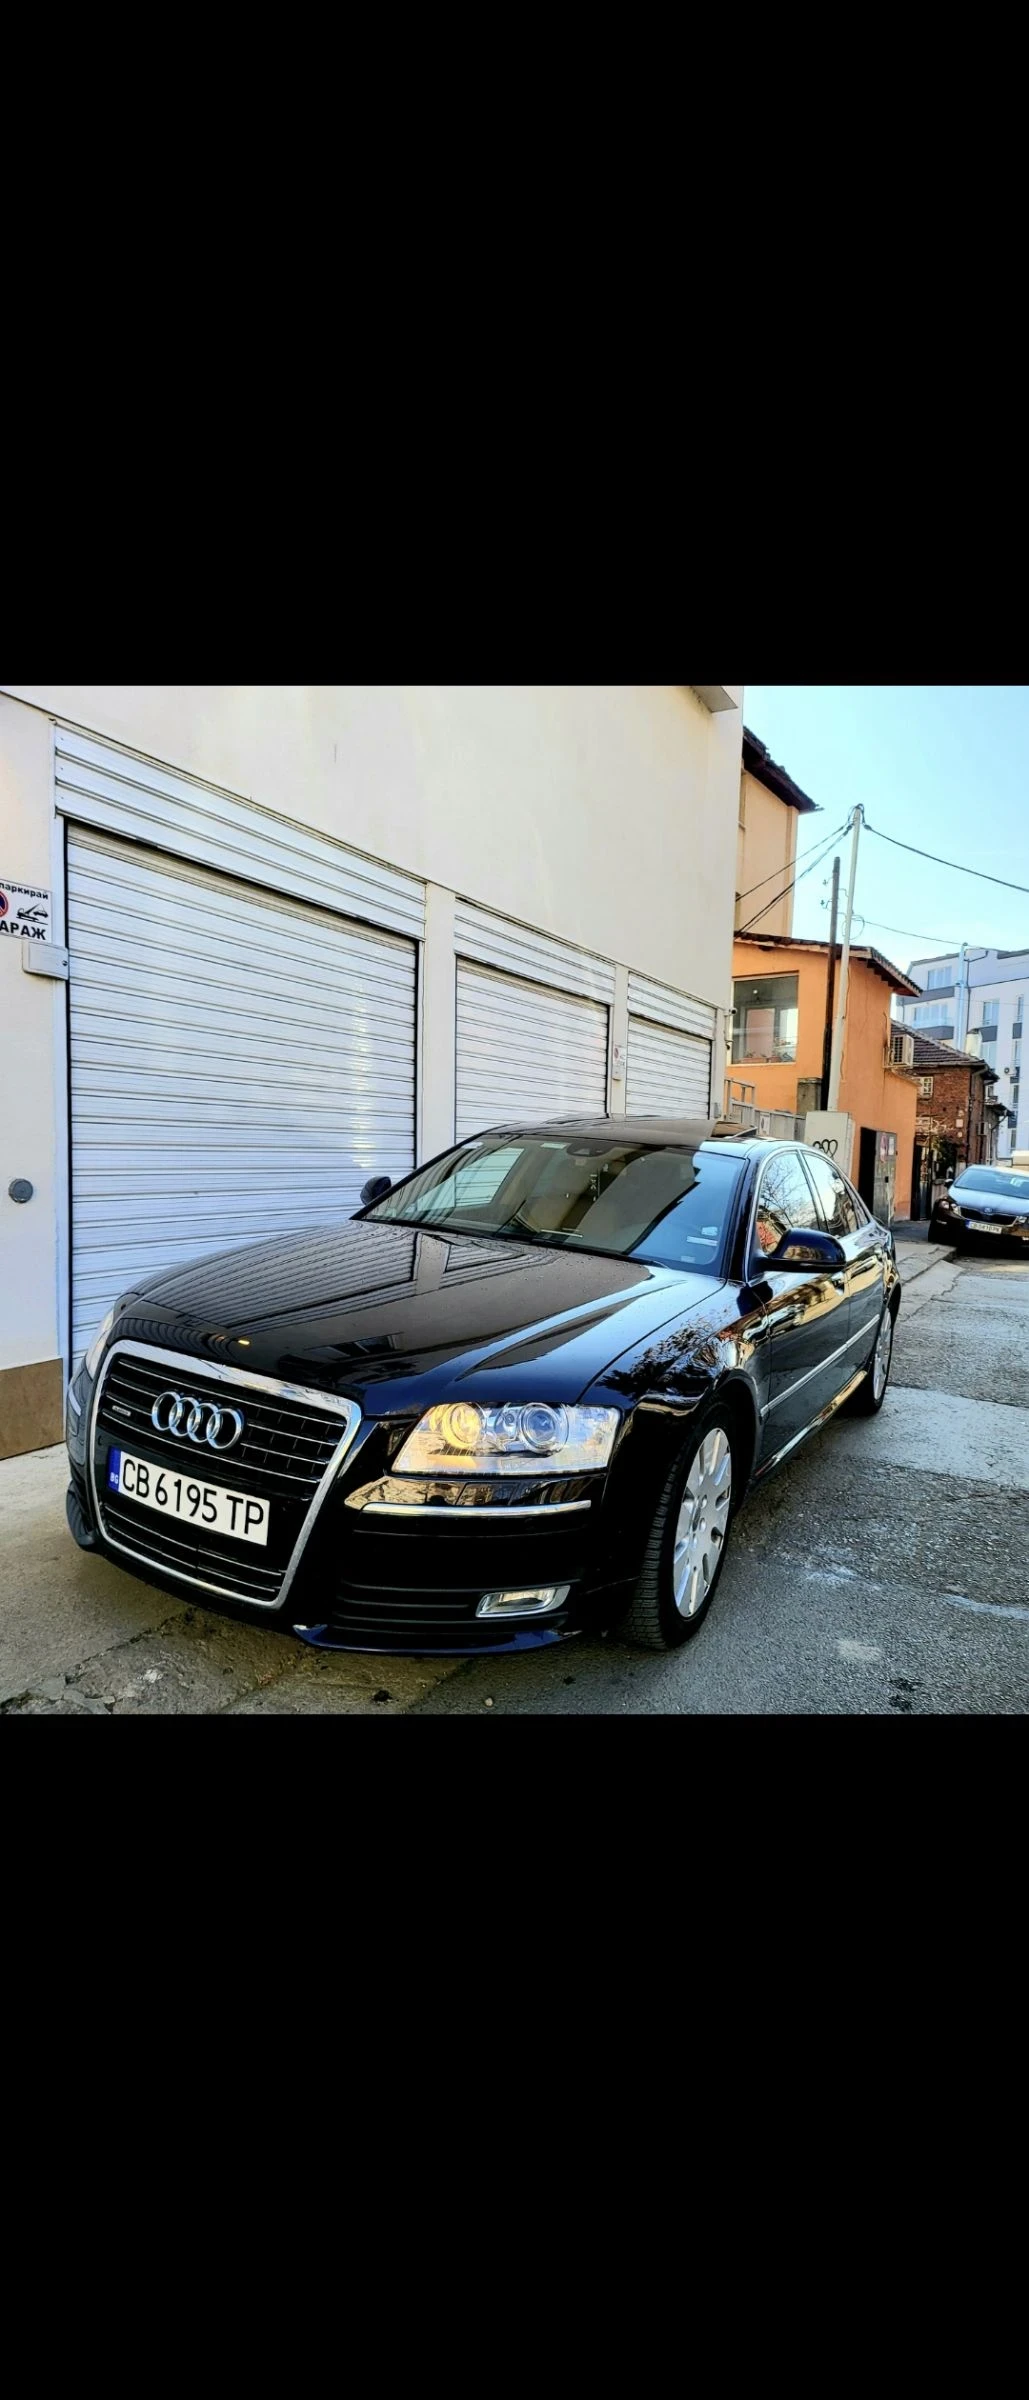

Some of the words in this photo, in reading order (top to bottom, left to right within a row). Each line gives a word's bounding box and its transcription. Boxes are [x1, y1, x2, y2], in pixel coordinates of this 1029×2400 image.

[110, 1472, 119, 1485] BG
[123, 1459, 150, 1499] CB
[155, 1473, 217, 1523] 6195
[226, 1494, 264, 1534] TP
